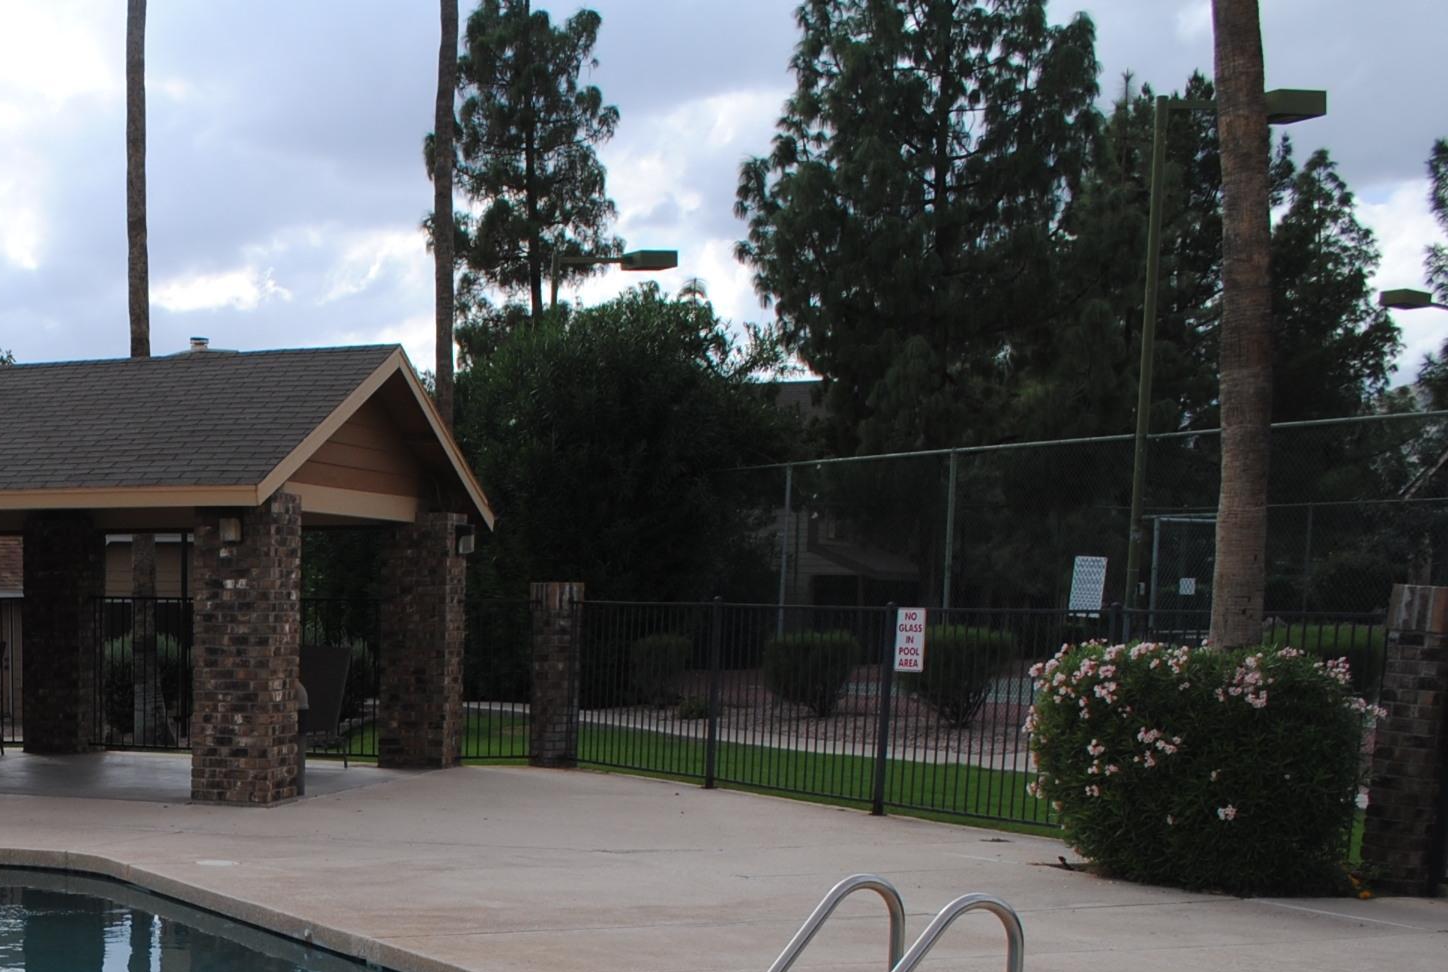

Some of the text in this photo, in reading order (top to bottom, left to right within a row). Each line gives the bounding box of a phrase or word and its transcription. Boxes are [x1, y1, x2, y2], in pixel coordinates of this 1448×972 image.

[905, 612, 918, 621] NO
[898, 624, 922, 632] GLASS
[905, 636, 914, 644] IN
[898, 647, 920, 656] POOL
[898, 659, 918, 667] AREA
